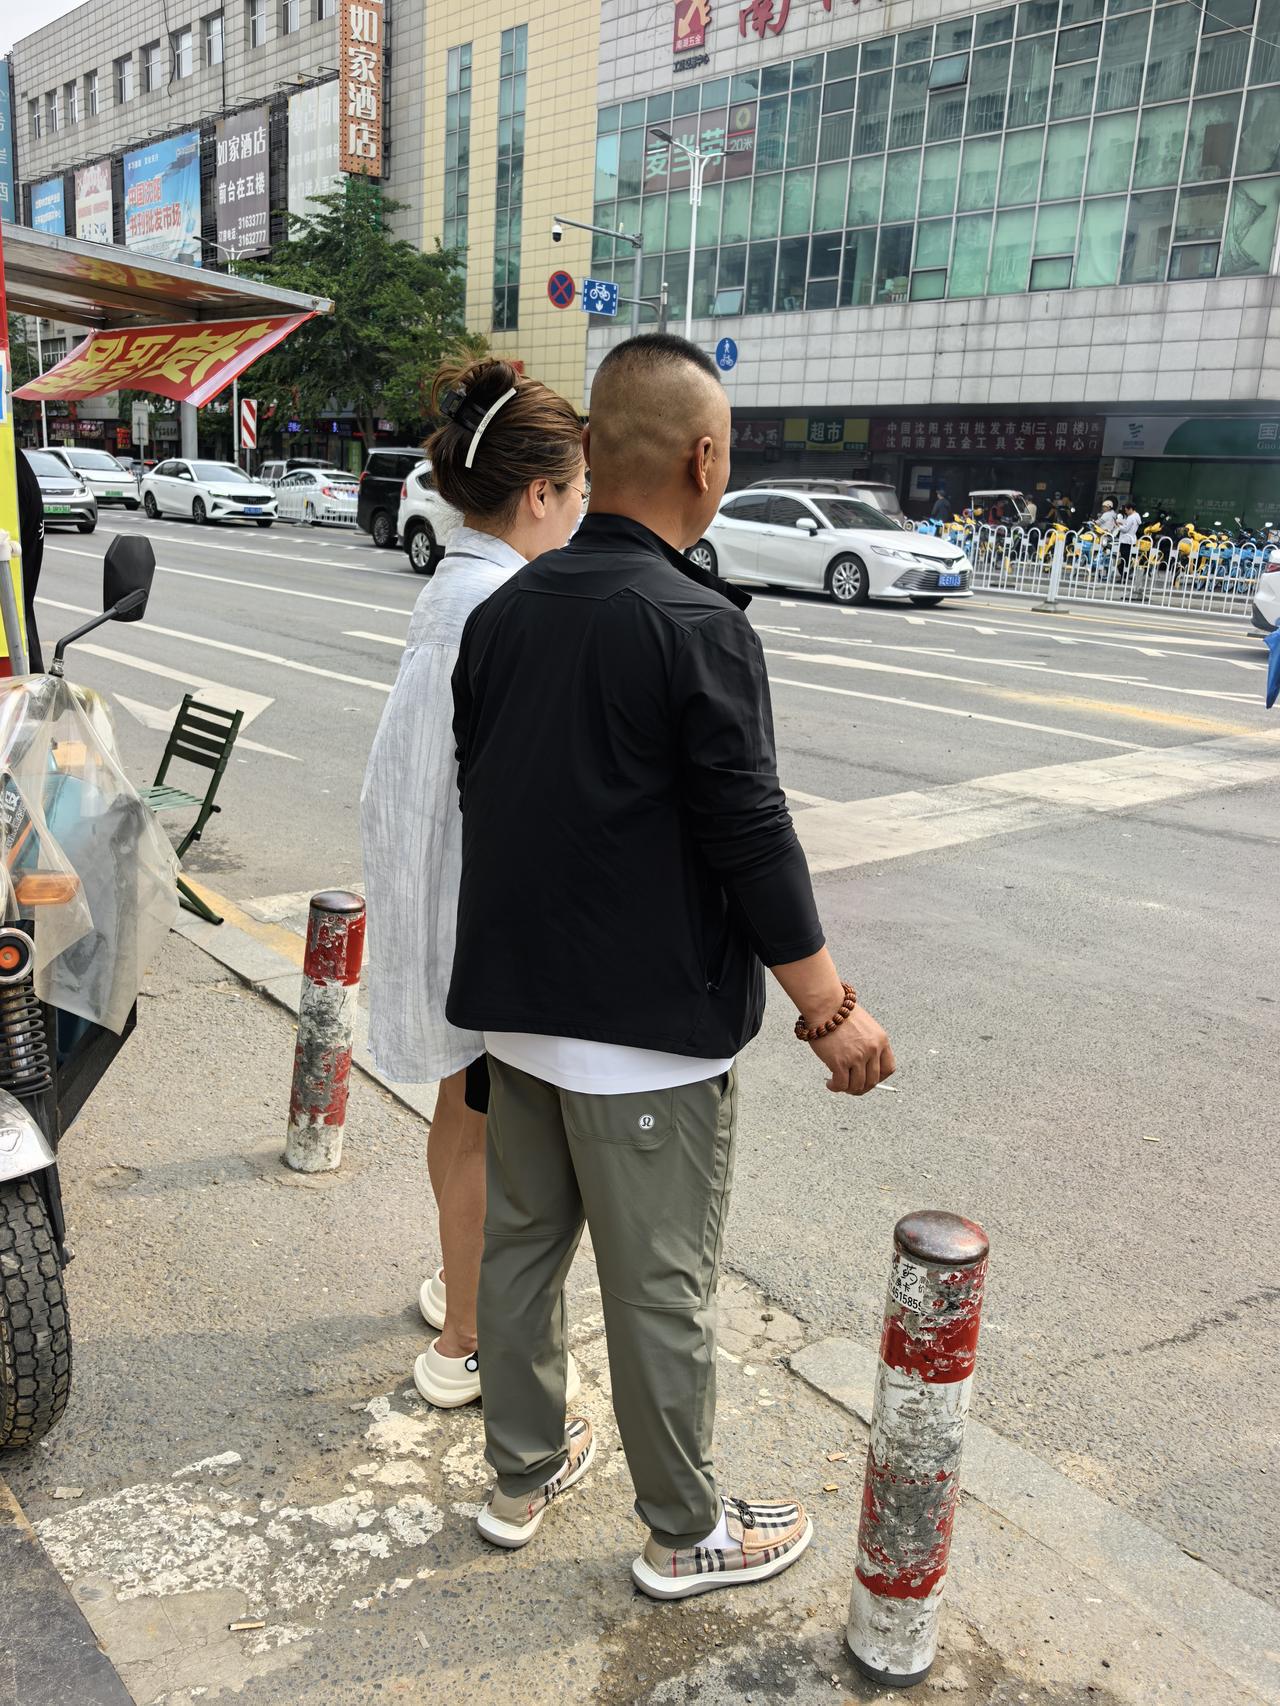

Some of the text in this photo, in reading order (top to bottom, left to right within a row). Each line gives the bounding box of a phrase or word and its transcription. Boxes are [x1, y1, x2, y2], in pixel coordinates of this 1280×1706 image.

[348, 4, 378, 158] 如家酒店
[217, 126, 266, 167] 如家酒店
[646, 128, 725, 180] 麦当劳
[218, 171, 265, 205] 前台在五楼
[129, 202, 182, 236] 书刊批发市场
[810, 421, 842, 442] 超市
[886, 436, 1085, 451] 沈阳南湖五金工具交易中心
